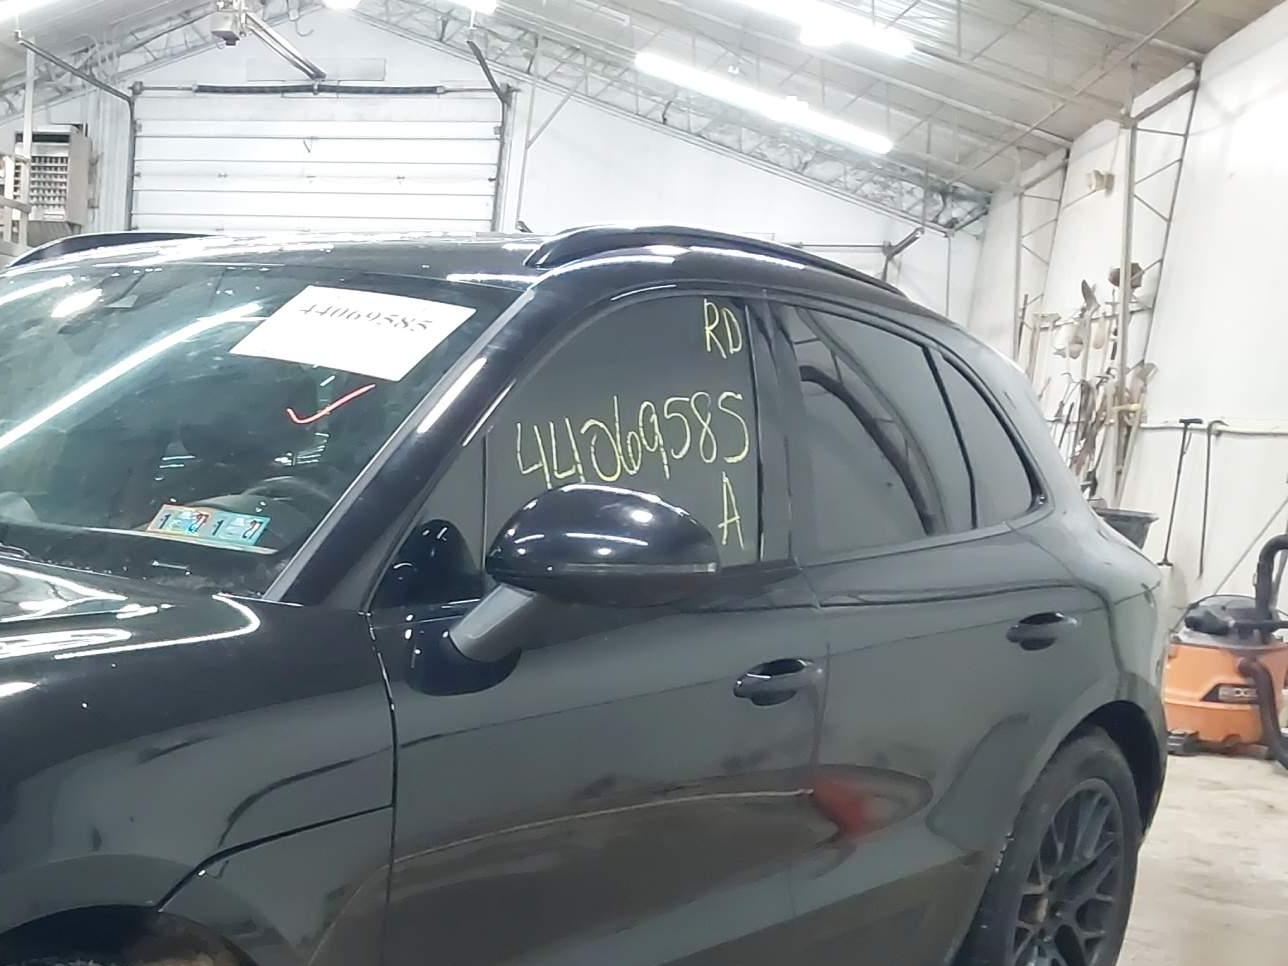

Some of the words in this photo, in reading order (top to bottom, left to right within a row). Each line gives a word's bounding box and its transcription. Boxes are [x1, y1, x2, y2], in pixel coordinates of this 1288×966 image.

[704, 298, 743, 359] RD
[516, 391, 750, 490] 44069585
[717, 471, 745, 550] A
